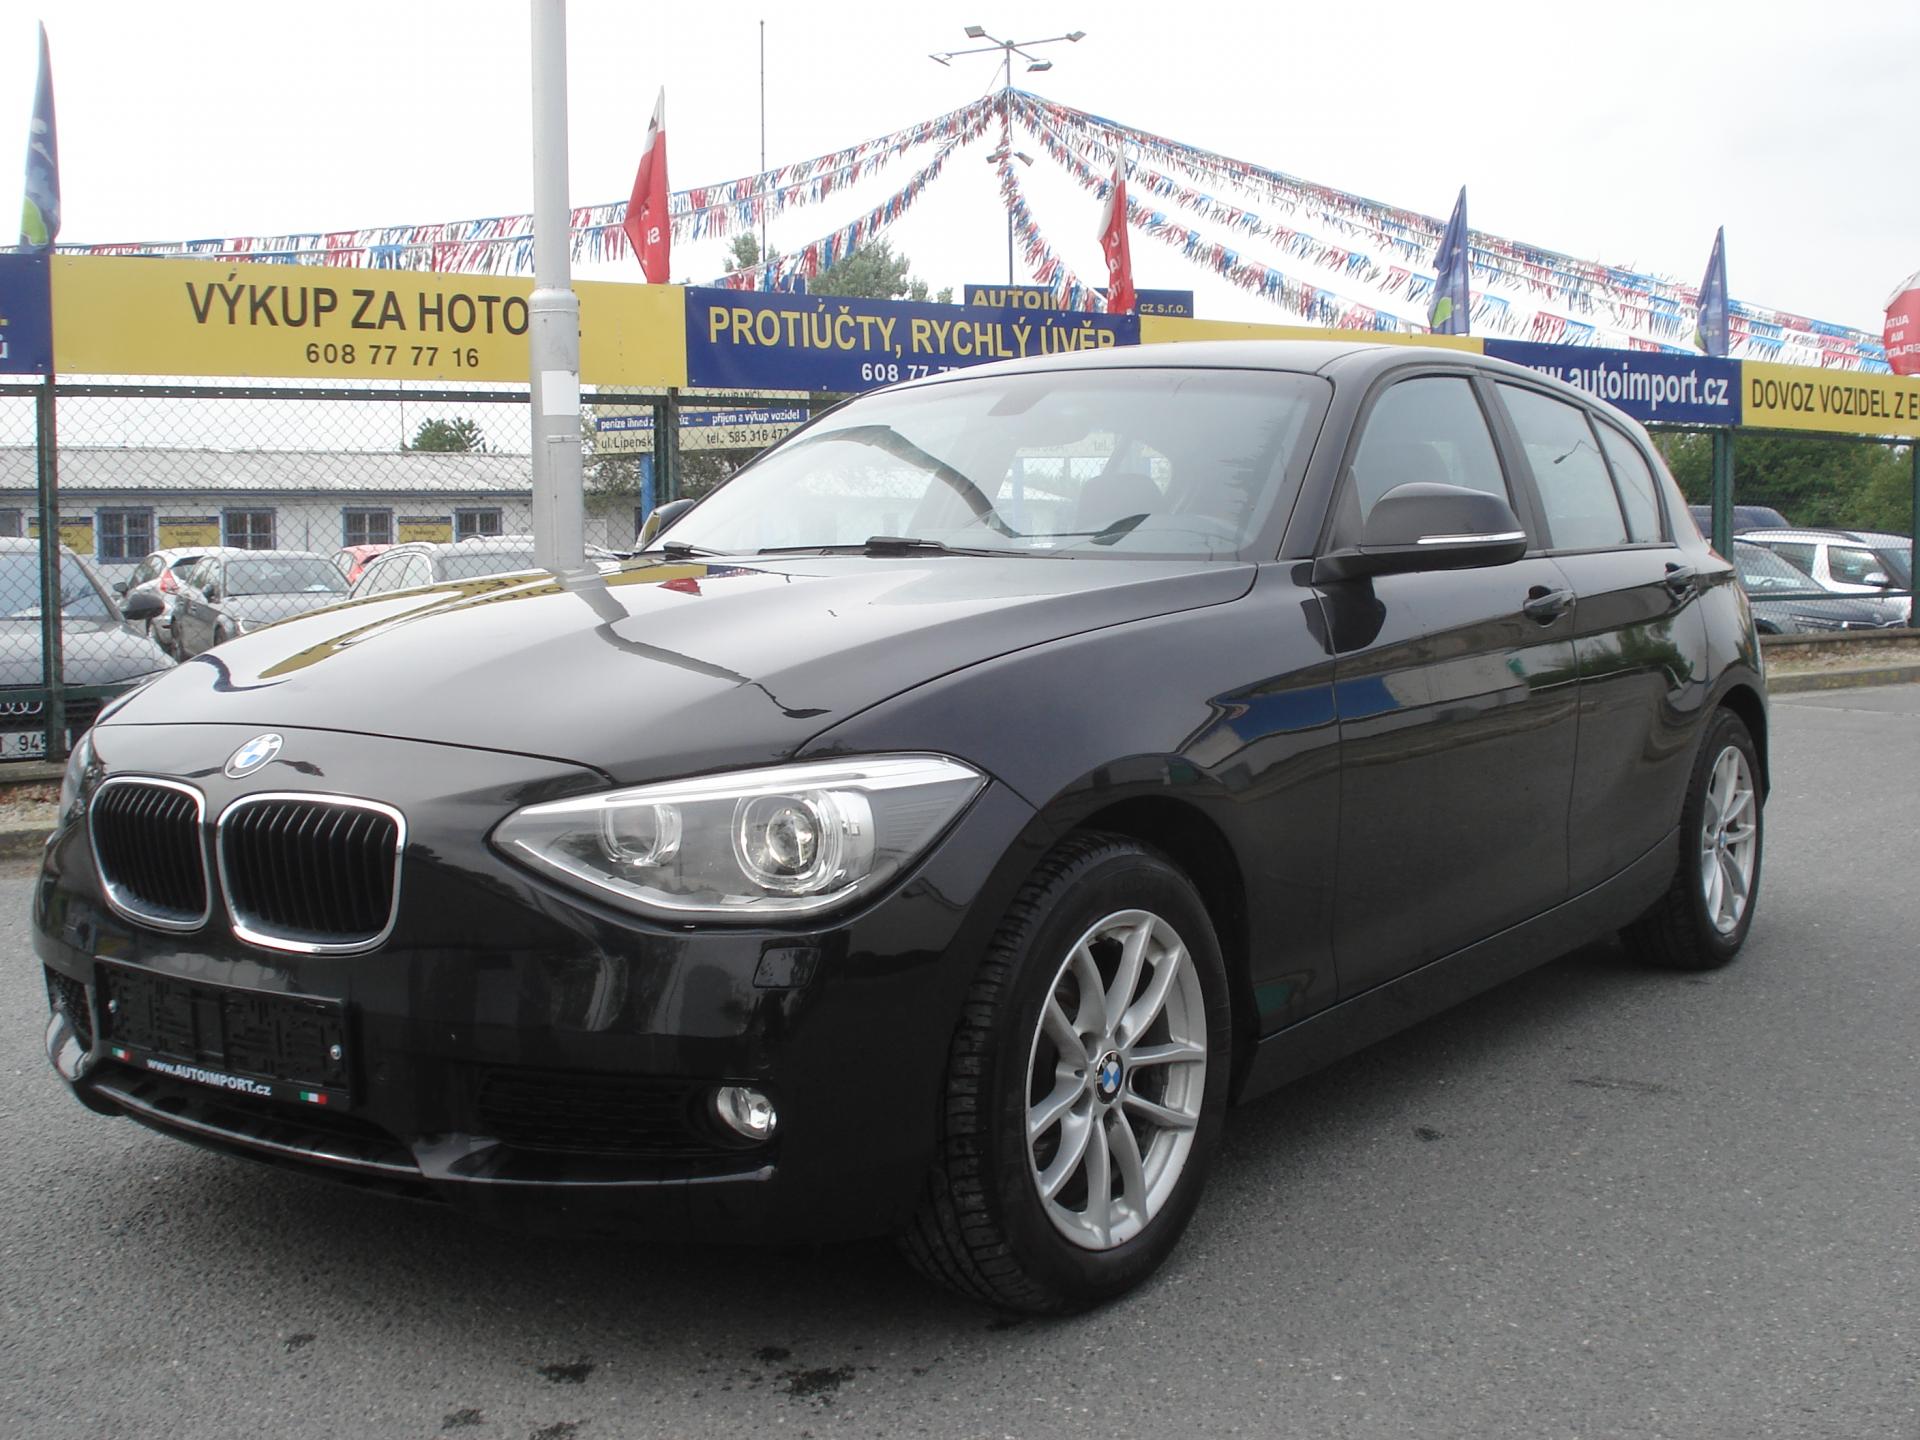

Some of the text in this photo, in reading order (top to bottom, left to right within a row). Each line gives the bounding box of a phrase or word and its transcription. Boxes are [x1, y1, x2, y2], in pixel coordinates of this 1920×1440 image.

[186, 273, 581, 336] VÝKUP ZA HOTO
[1158, 303, 1188, 314] s.r.o.
[709, 304, 902, 359] PROTIÚČTY,
[911, 317, 1032, 358] RYCHLÝ
[306, 343, 479, 367] 608 77 77 16
[861, 363, 899, 382] 608
[1752, 378, 1920, 420] DOVOZ VOZIDEL Z E
[745, 410, 769, 424] výkup
[771, 408, 800, 421] vozidel
[728, 431, 747, 443] 585
[749, 429, 768, 442] 316
[147, 1059, 272, 1096] www.AUTOIMPORT.cz
